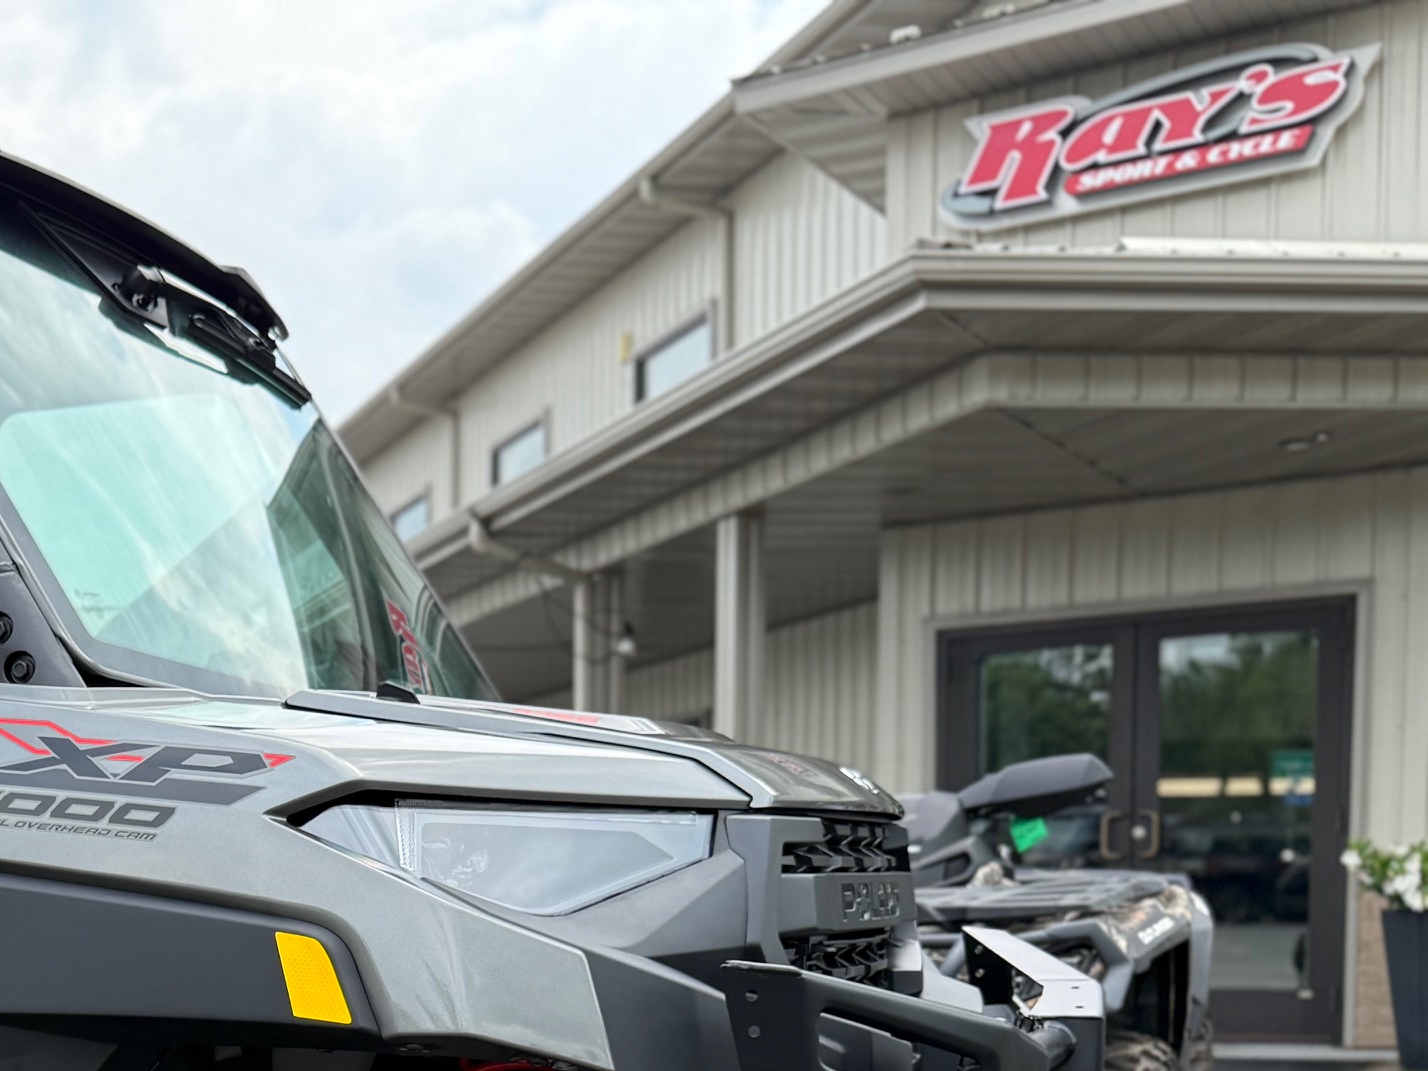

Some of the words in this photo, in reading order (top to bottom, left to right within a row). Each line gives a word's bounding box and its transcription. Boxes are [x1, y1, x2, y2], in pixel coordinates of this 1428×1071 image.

[1076, 154, 1173, 192] SPORT
[1175, 149, 1199, 171] &
[1206, 128, 1302, 164] CYCLE
[14, 821, 110, 836] OVERHEAD
[114, 830, 157, 841] CAM
